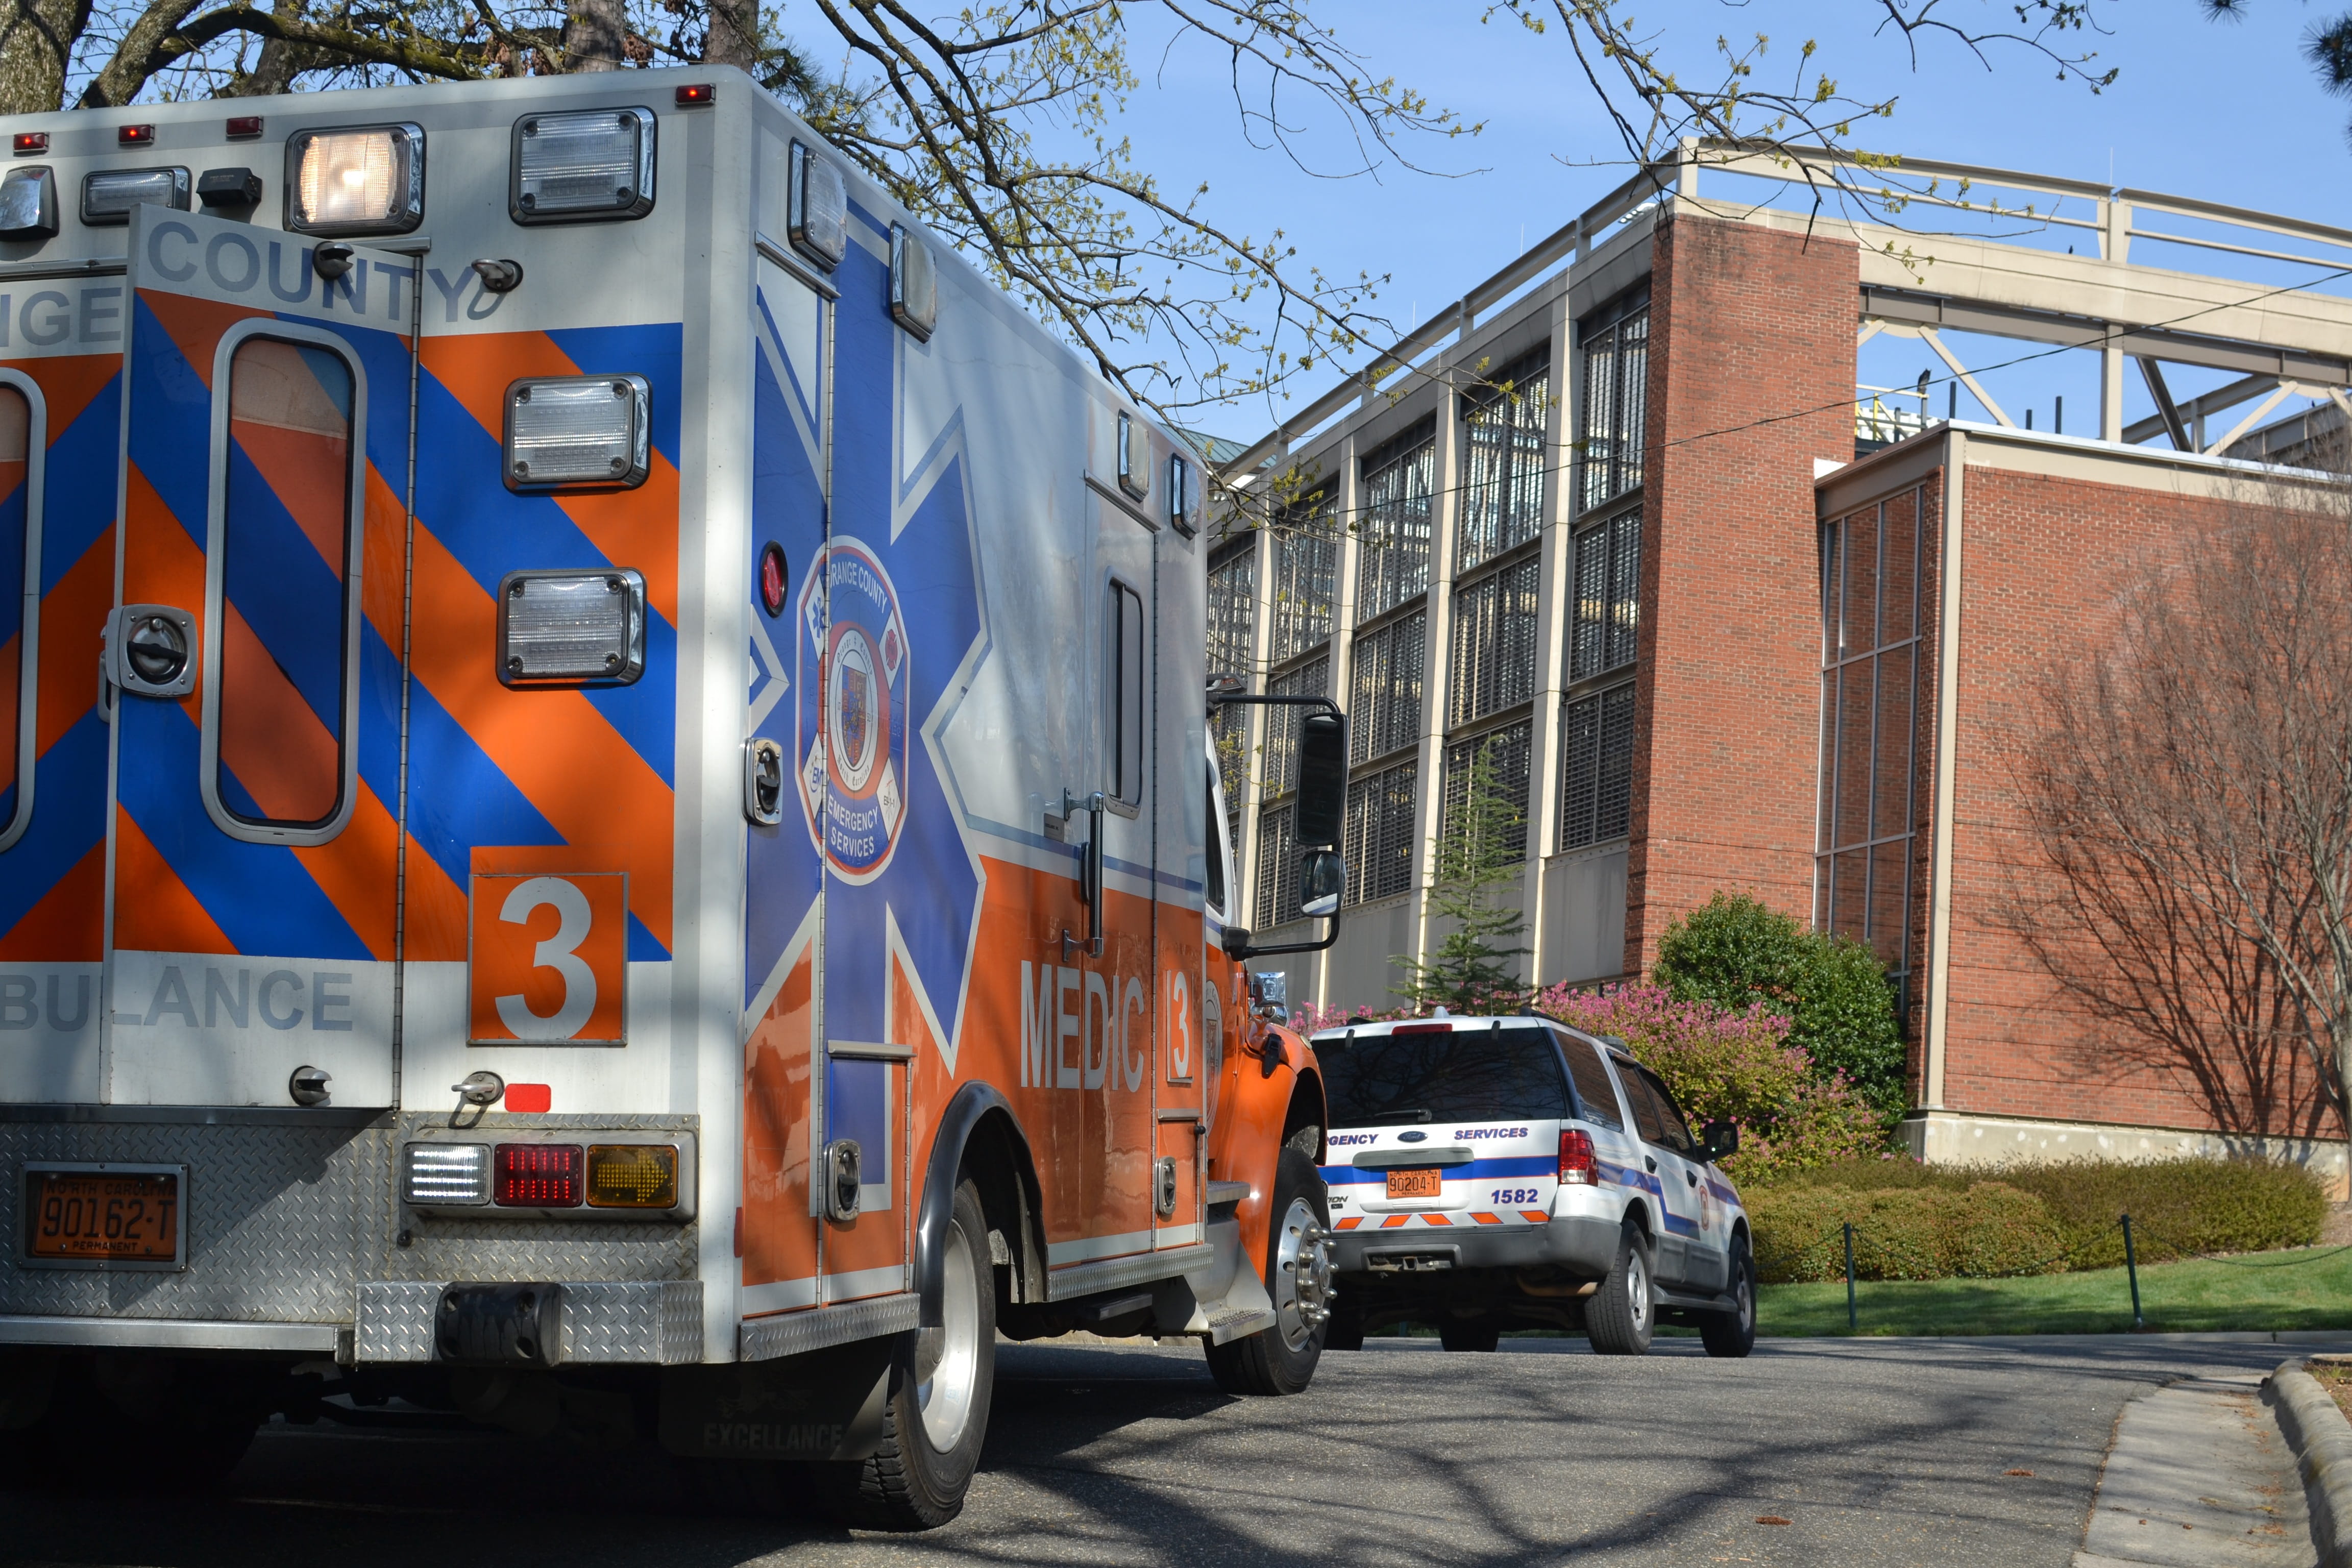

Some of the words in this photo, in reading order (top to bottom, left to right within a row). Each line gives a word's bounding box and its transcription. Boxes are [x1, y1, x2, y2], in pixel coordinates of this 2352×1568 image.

[0, 287, 121, 348] GE
[148, 222, 477, 323] COUNTY
[830, 561, 857, 589] RANGE
[859, 567, 887, 614] COUNTY
[827, 794, 877, 831] EMERGENCY
[831, 826, 874, 857] SERVICES
[495, 876, 598, 1040] 3
[1021, 960, 1145, 1093] MEDIC
[1173, 971, 1189, 1079] 3
[1327, 1134, 1379, 1146] GENCY
[1454, 1128, 1528, 1140] SERVICES
[47, 1182, 97, 1194] NORTH
[105, 1183, 177, 1197] CAROLINA
[1390, 1176, 1437, 1191] 90204-T
[1491, 1188, 1538, 1205] 1582
[44, 1196, 175, 1240] 90162-T
[72, 1241, 139, 1252] PERMANENT
[703, 1423, 843, 1452] EXCELLANCE
